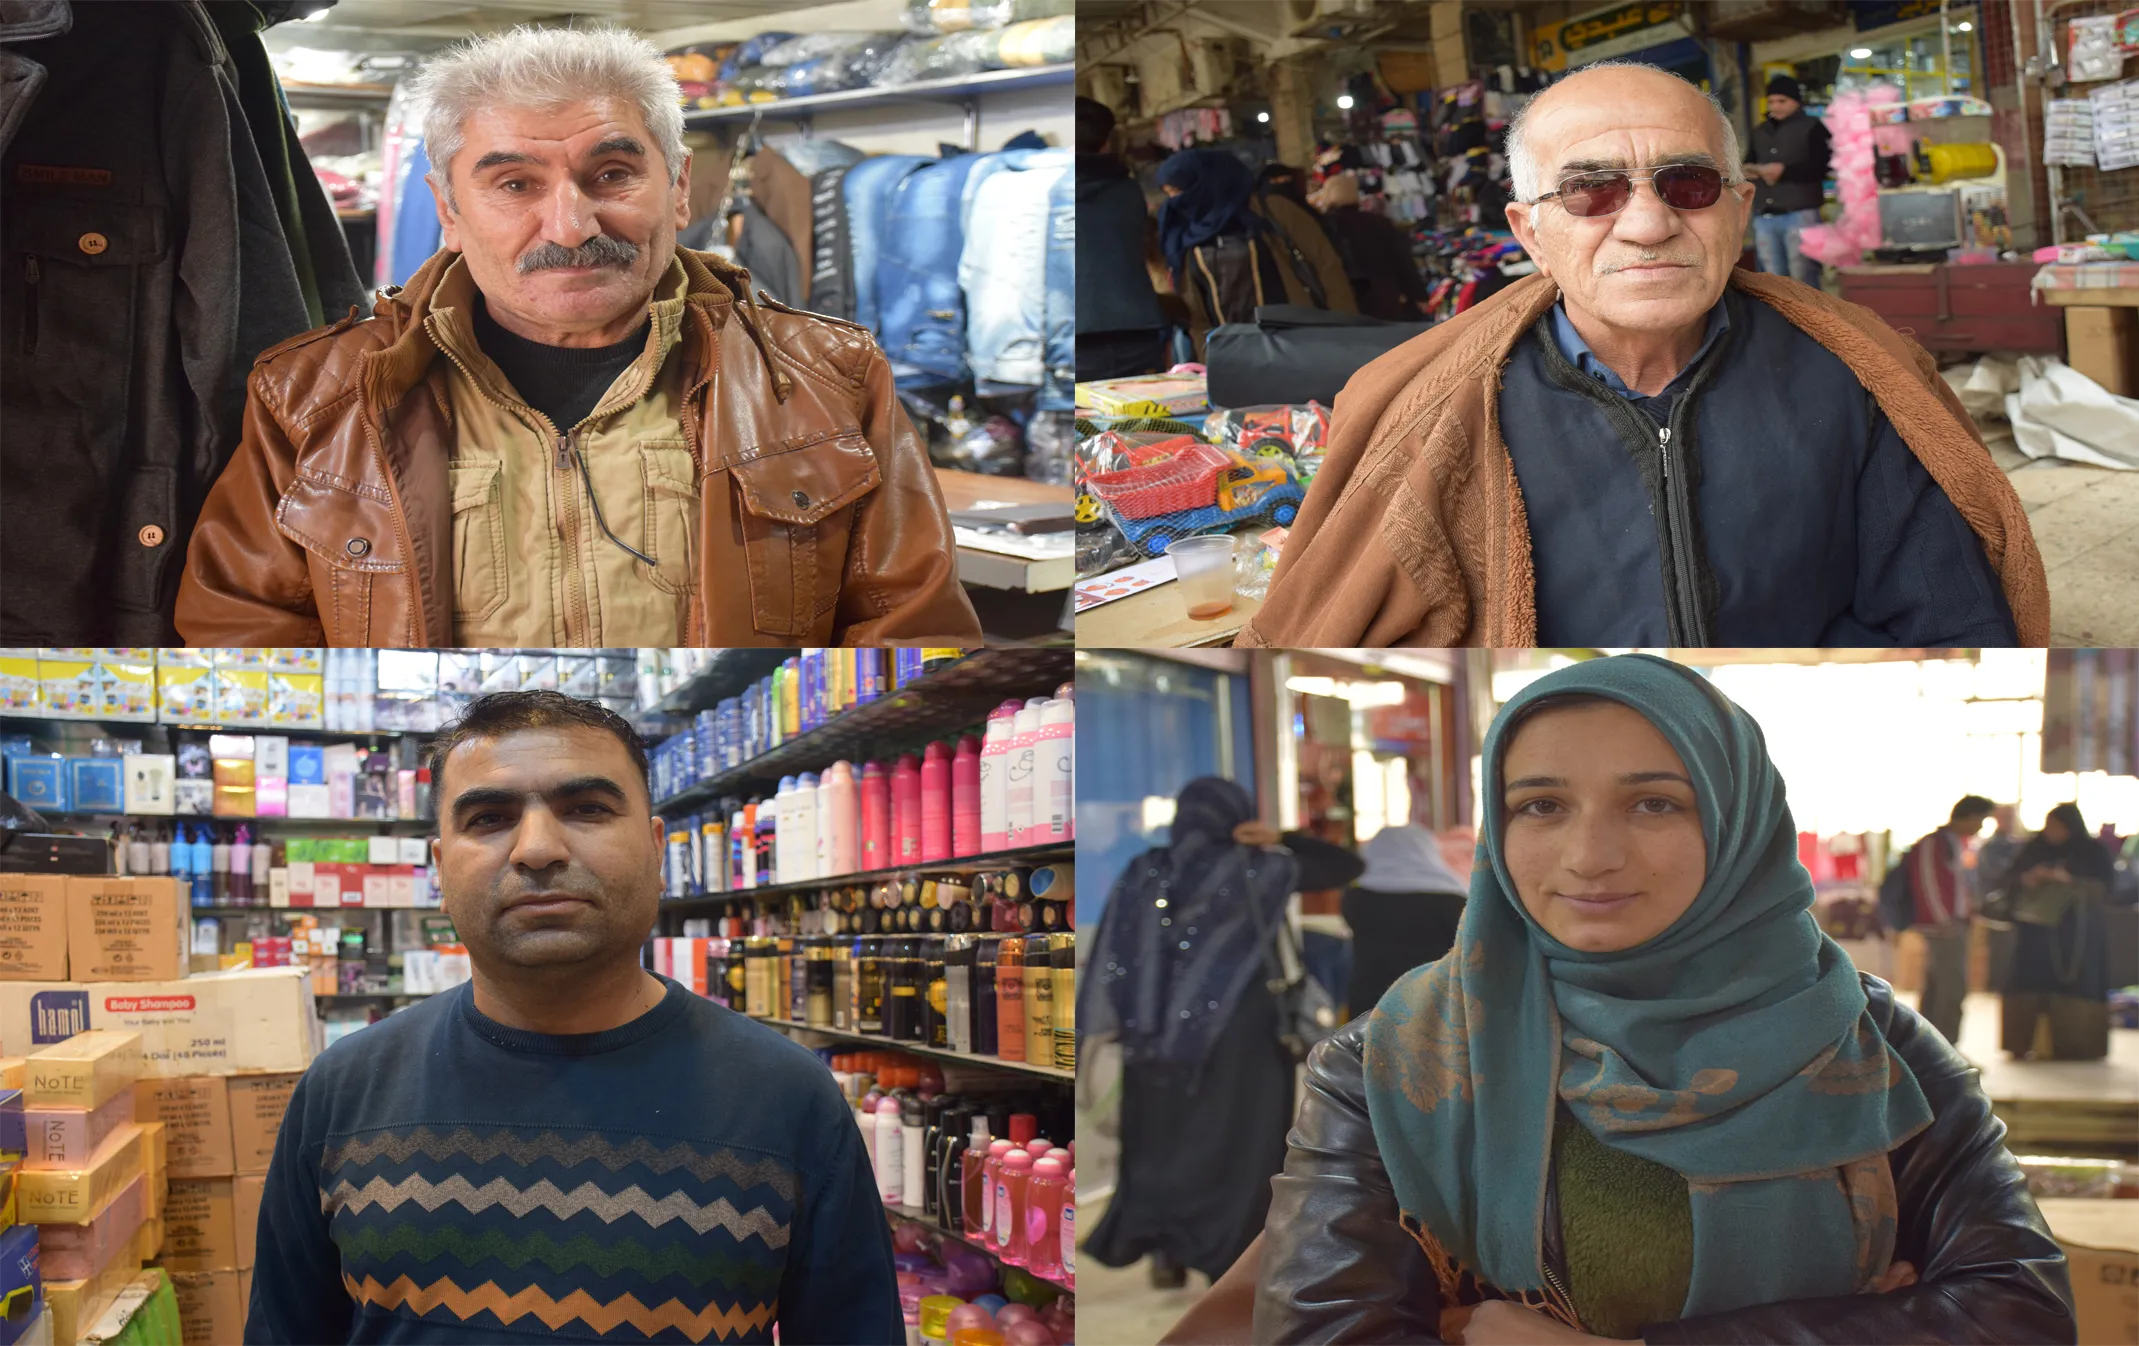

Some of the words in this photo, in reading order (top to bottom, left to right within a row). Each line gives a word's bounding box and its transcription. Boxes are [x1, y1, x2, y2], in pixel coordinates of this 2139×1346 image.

[73, 170, 108, 183] MAN
[110, 998, 138, 1012] Baby
[139, 997, 190, 1012] Shampoo
[190, 1038, 210, 1047] 250
[213, 1038, 226, 1046] ml
